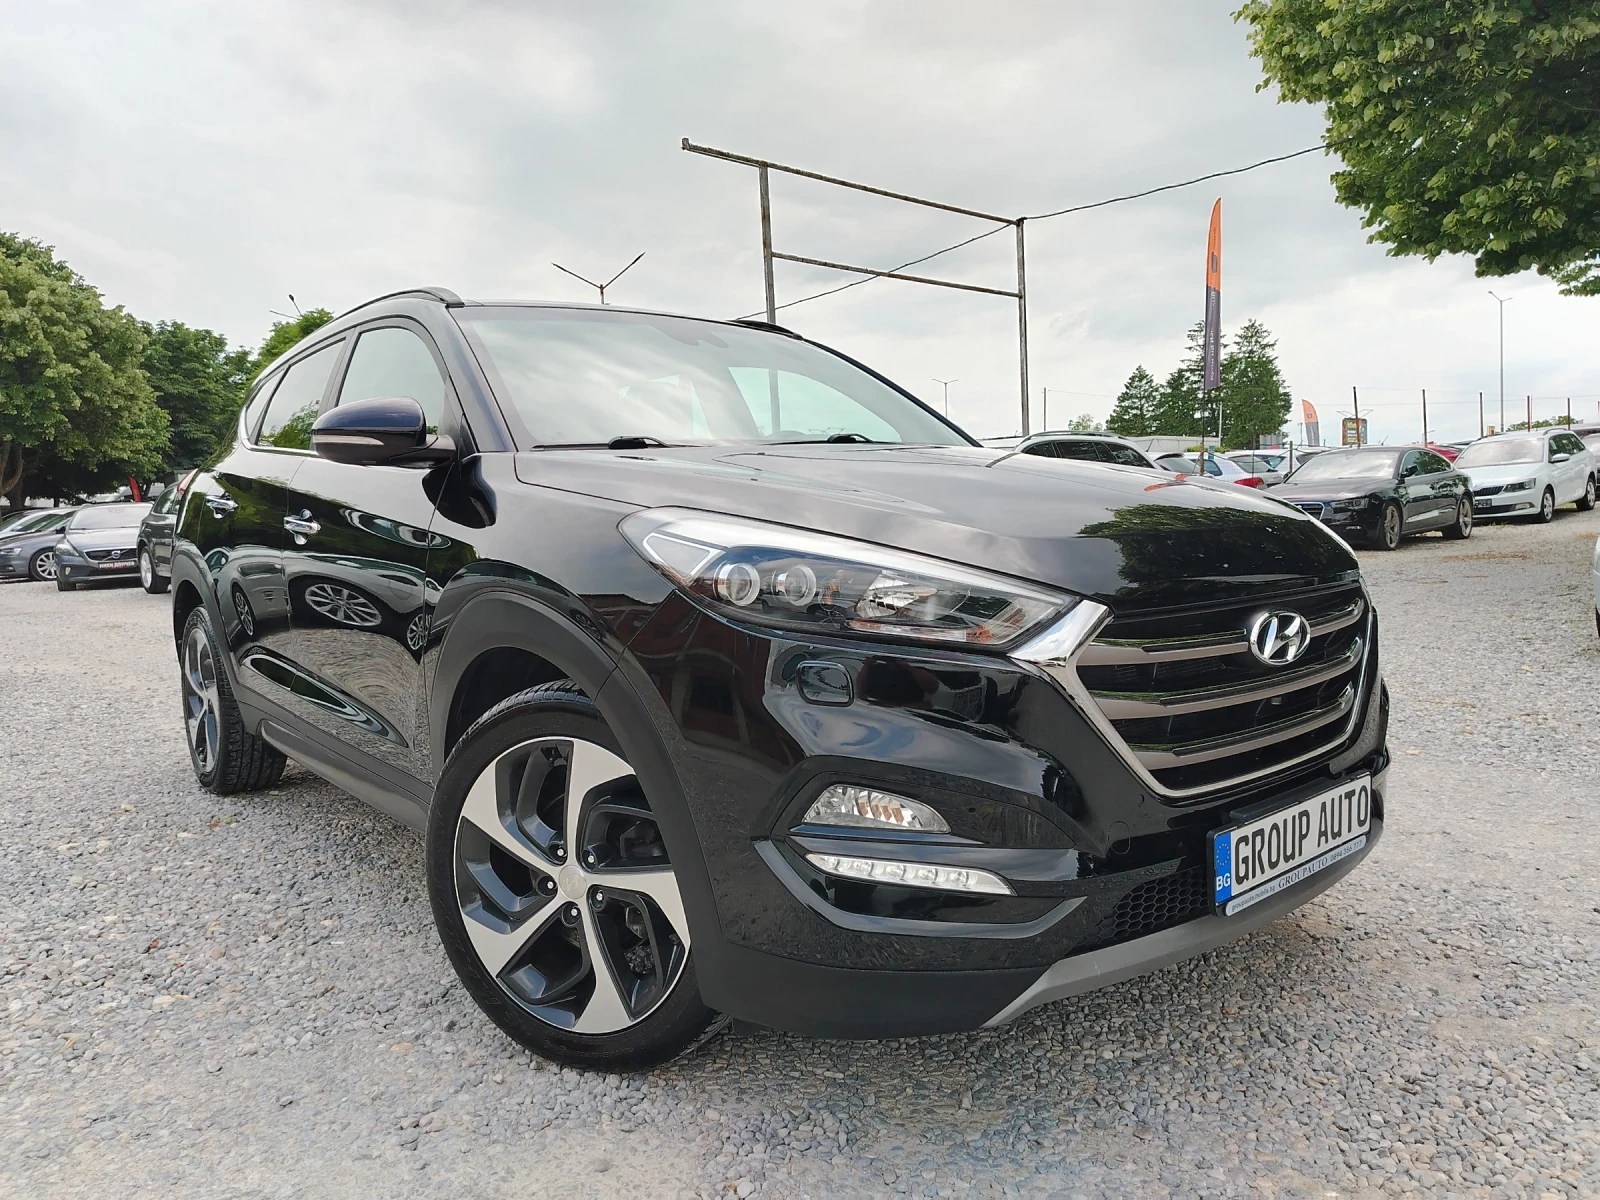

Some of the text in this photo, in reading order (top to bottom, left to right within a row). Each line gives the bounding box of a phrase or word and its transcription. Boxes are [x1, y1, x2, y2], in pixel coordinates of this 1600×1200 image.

[1234, 785, 1369, 885] GROUP AUTO
[1216, 872, 1231, 891] BG
[1278, 857, 1328, 889] GROUPAUTO
